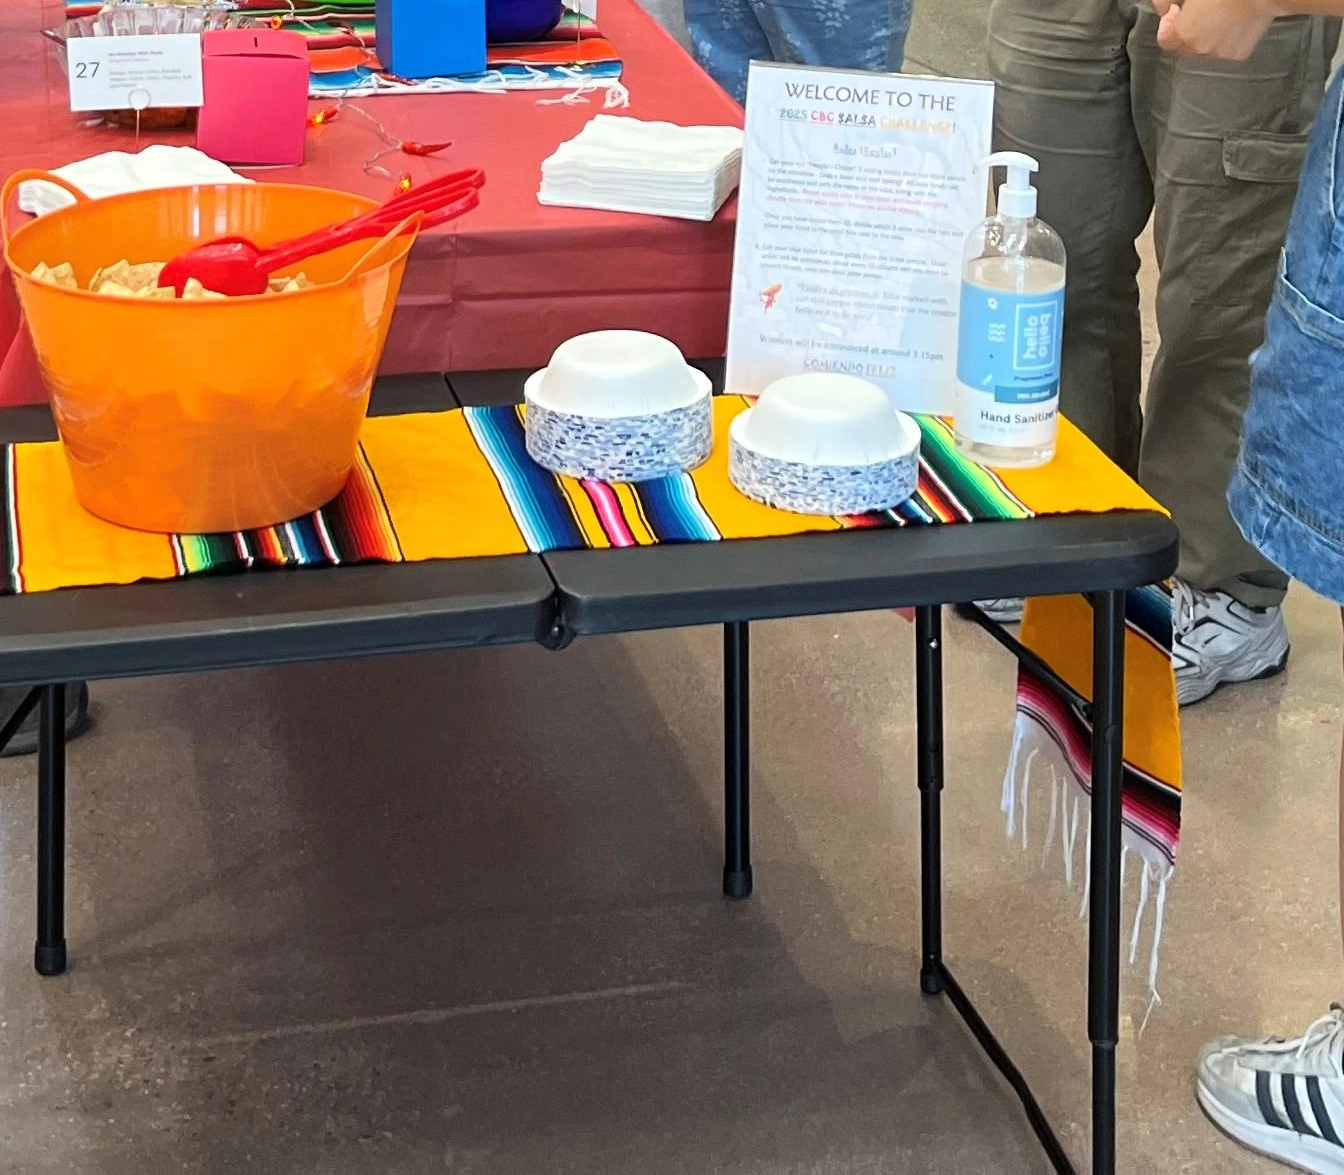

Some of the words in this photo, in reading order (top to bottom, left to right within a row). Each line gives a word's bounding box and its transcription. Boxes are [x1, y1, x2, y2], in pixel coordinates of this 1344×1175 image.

[75, 62, 100, 79] 27
[785, 82, 880, 105] WELCOME
[885, 91, 912, 107] TO
[918, 93, 956, 111] THE
[779, 108, 807, 120] 2025
[810, 110, 834, 123] CBC
[838, 112, 876, 126] SALSA
[1022, 315, 1039, 359] hello
[913, 349, 944, 361] 315pm
[980, 410, 1011, 424] Hand
[1014, 410, 1055, 424] Sanitizer
